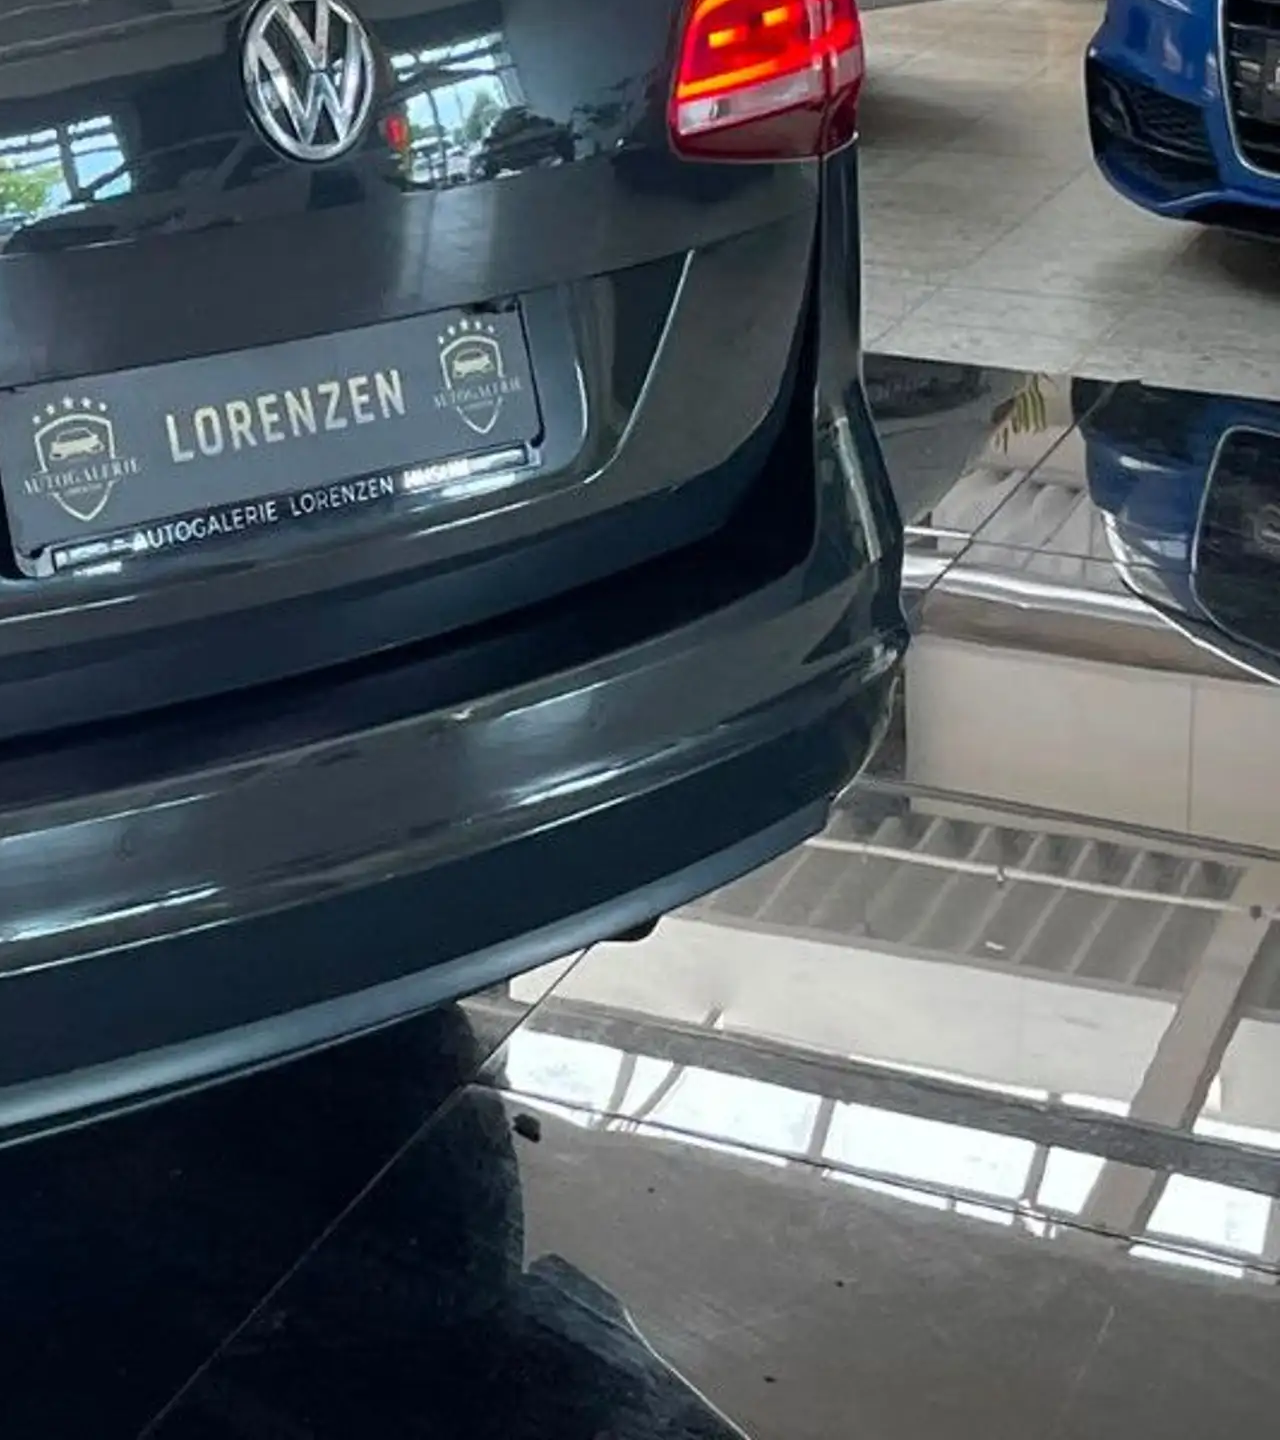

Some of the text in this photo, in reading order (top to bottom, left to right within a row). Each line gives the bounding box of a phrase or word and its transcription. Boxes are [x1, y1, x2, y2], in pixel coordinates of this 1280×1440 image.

[166, 369, 405, 462] LORENZEN
[132, 501, 278, 551] AUTOGALERIE
[290, 474, 394, 517] LORENZEN
